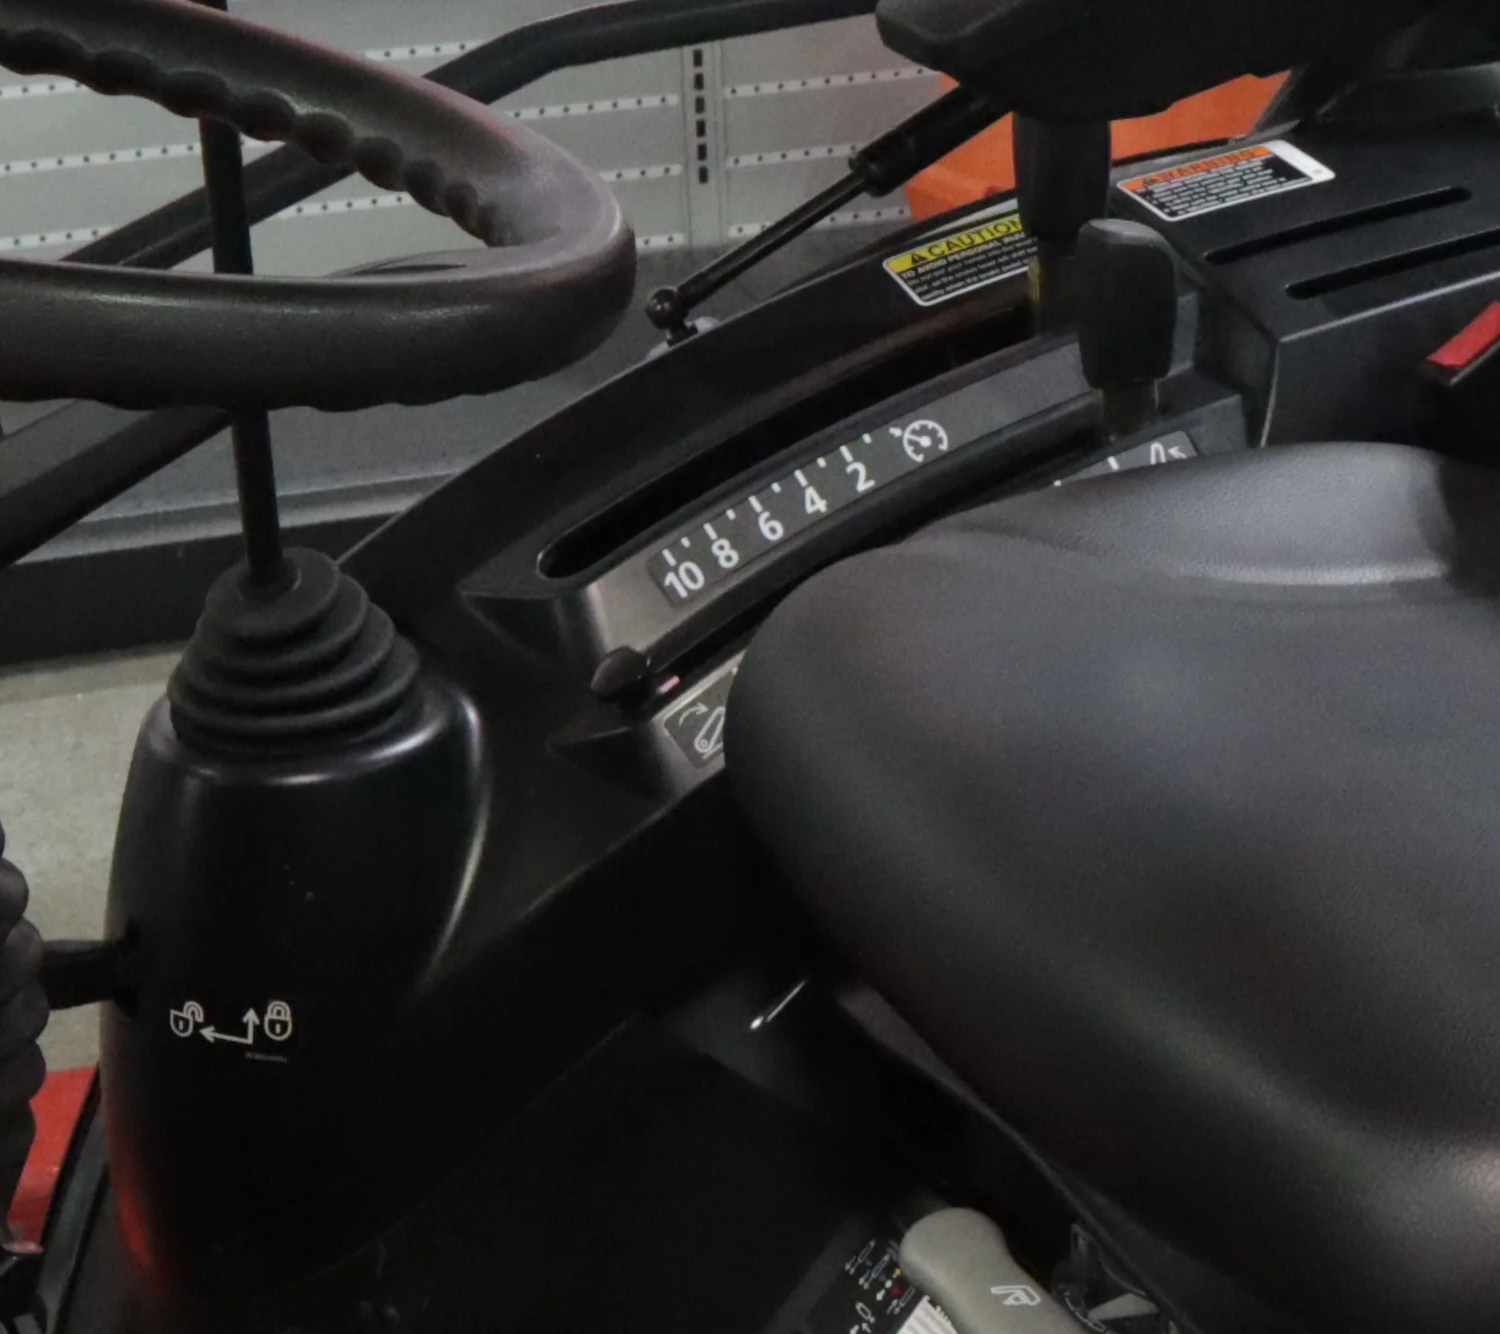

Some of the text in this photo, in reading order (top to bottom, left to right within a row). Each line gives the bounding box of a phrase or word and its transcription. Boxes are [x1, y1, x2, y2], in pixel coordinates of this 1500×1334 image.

[846, 462, 876, 492] 2
[803, 486, 828, 515] 4
[758, 511, 784, 541] 6
[711, 538, 739, 568] 8
[664, 560, 705, 598] 10
